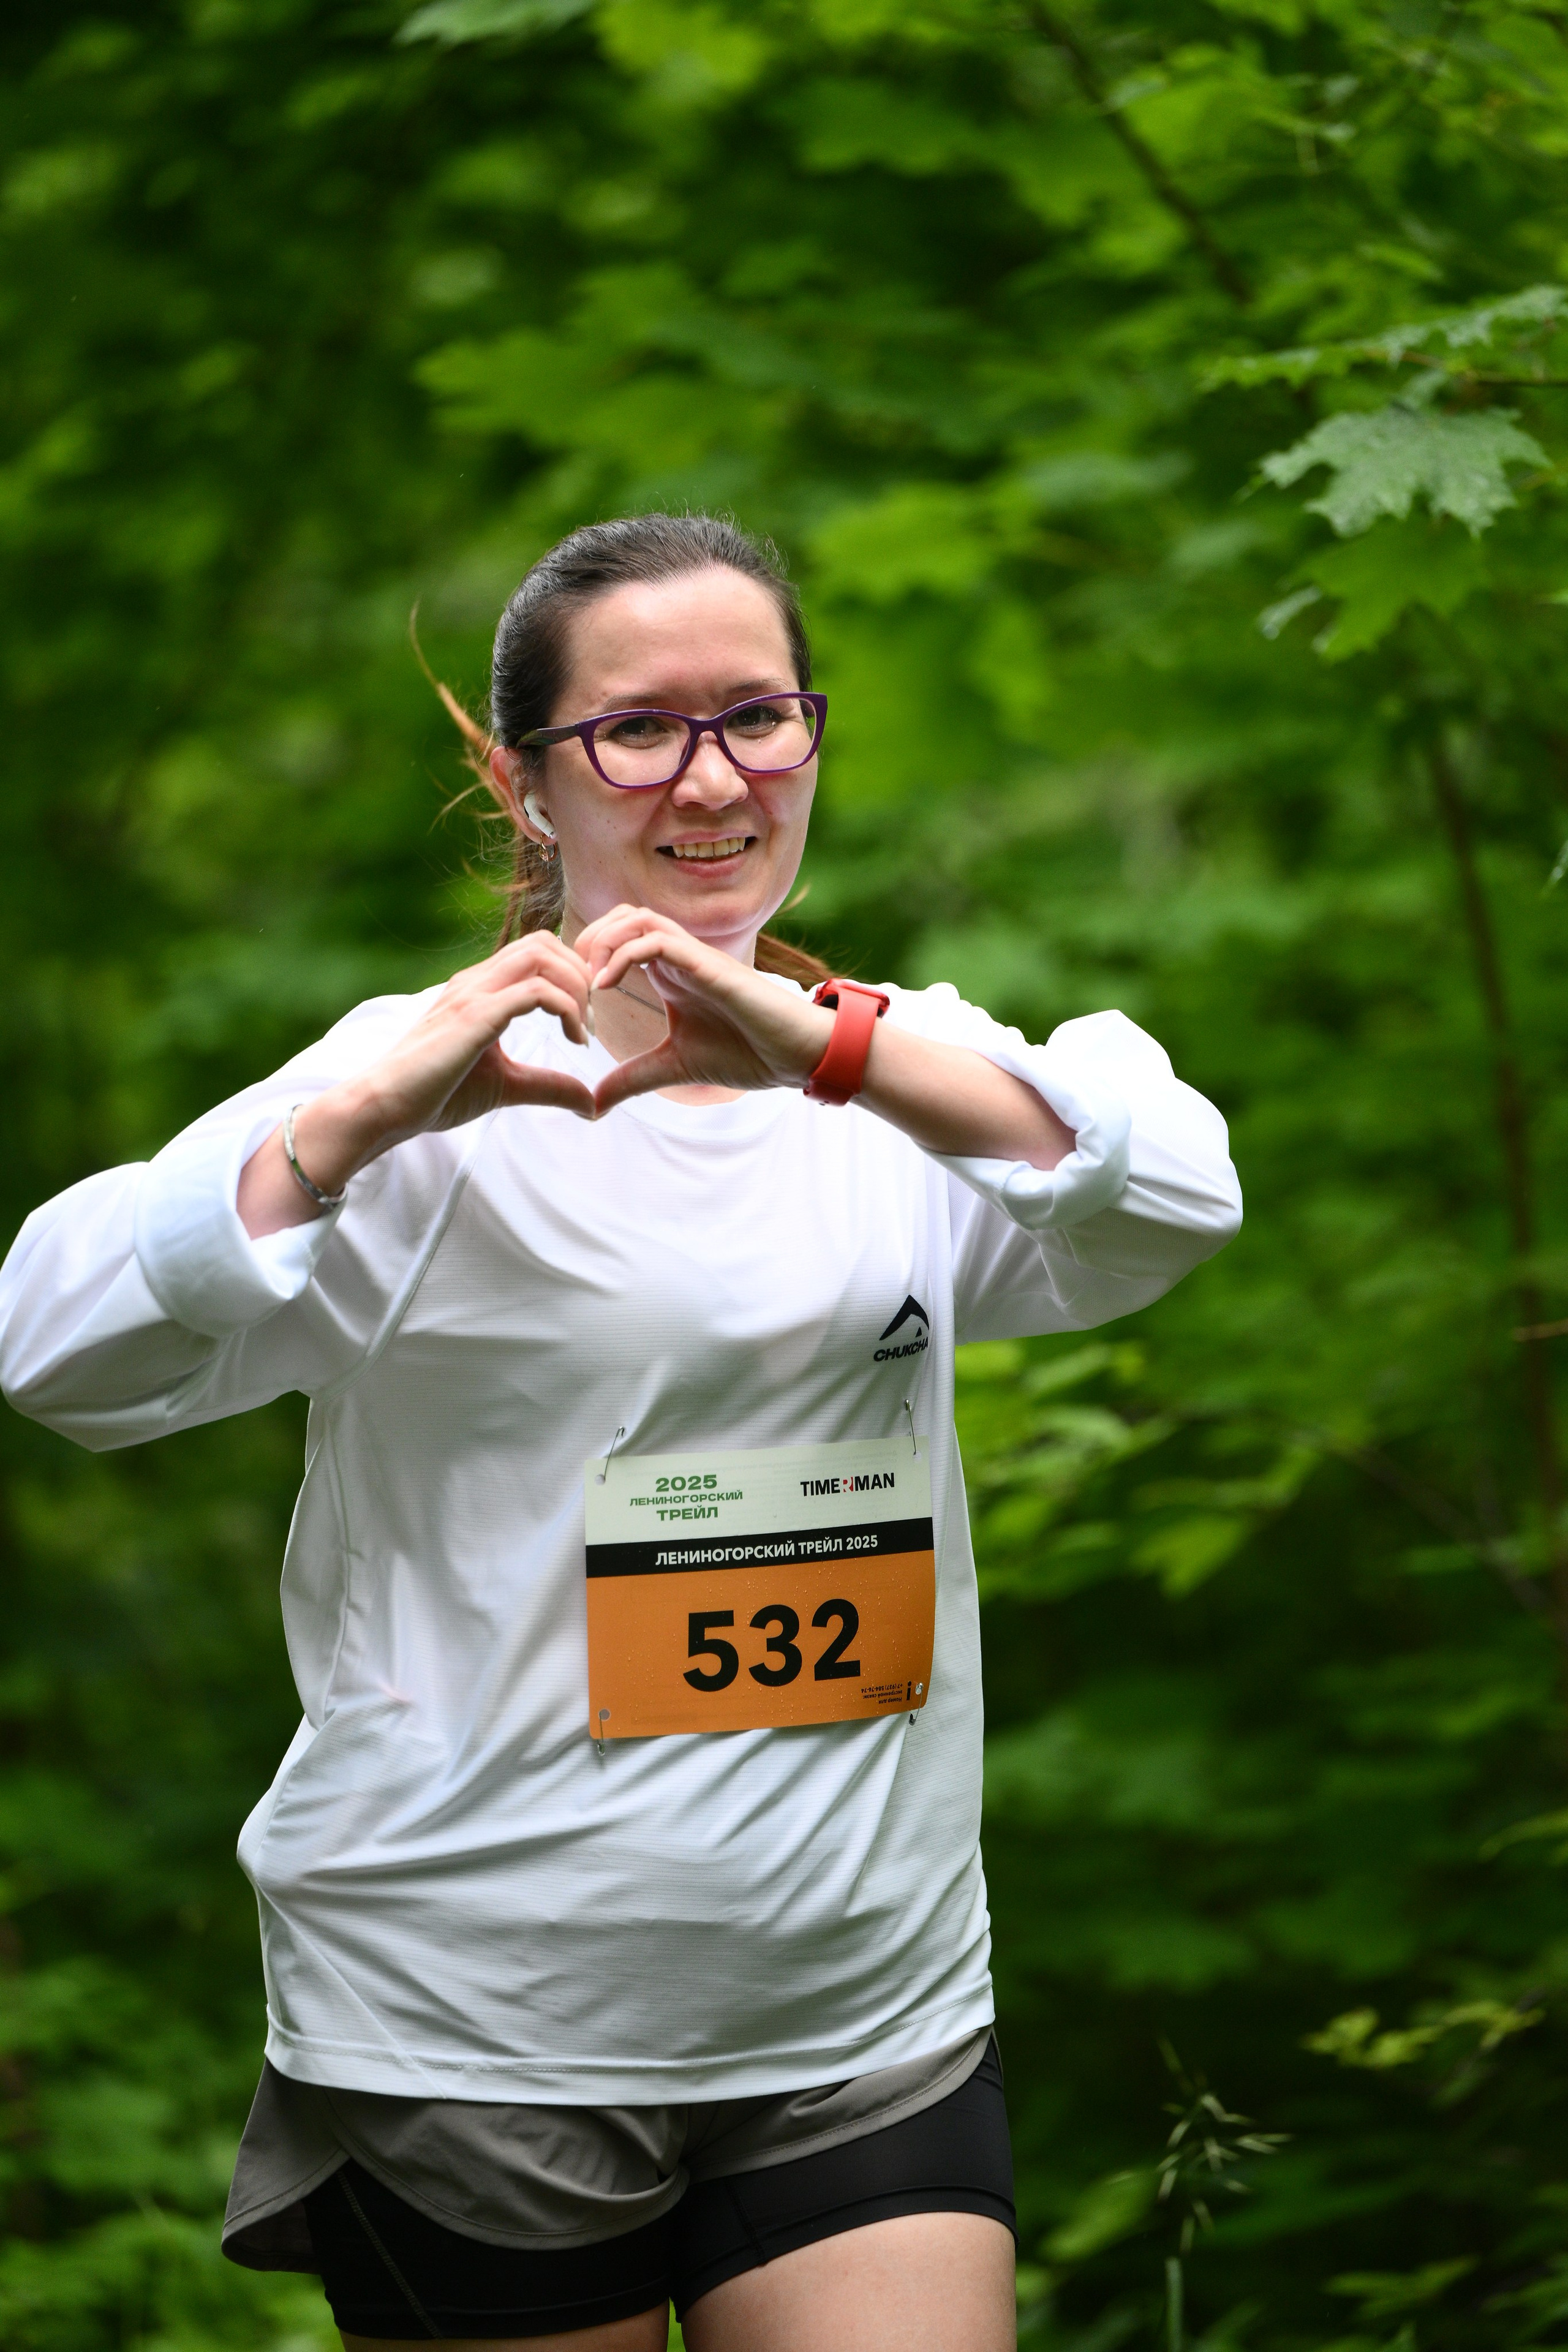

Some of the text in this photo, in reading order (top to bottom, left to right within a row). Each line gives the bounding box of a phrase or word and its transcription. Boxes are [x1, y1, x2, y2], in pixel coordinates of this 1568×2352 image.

[873, 1336, 928, 1362] CHUKCHA
[655, 1474, 717, 1492] 2025
[630, 1490, 743, 1506] ЛЕНИНОГОРСКИЙ
[656, 1505, 718, 1521] ТРЕЙЛ
[655, 1535, 878, 1566] ЛЕНИНОГОРСКИЙ ТРЕЙЛ 2025
[682, 1598, 861, 1692] 532
[877, 1690, 903, 1698] экстренной
